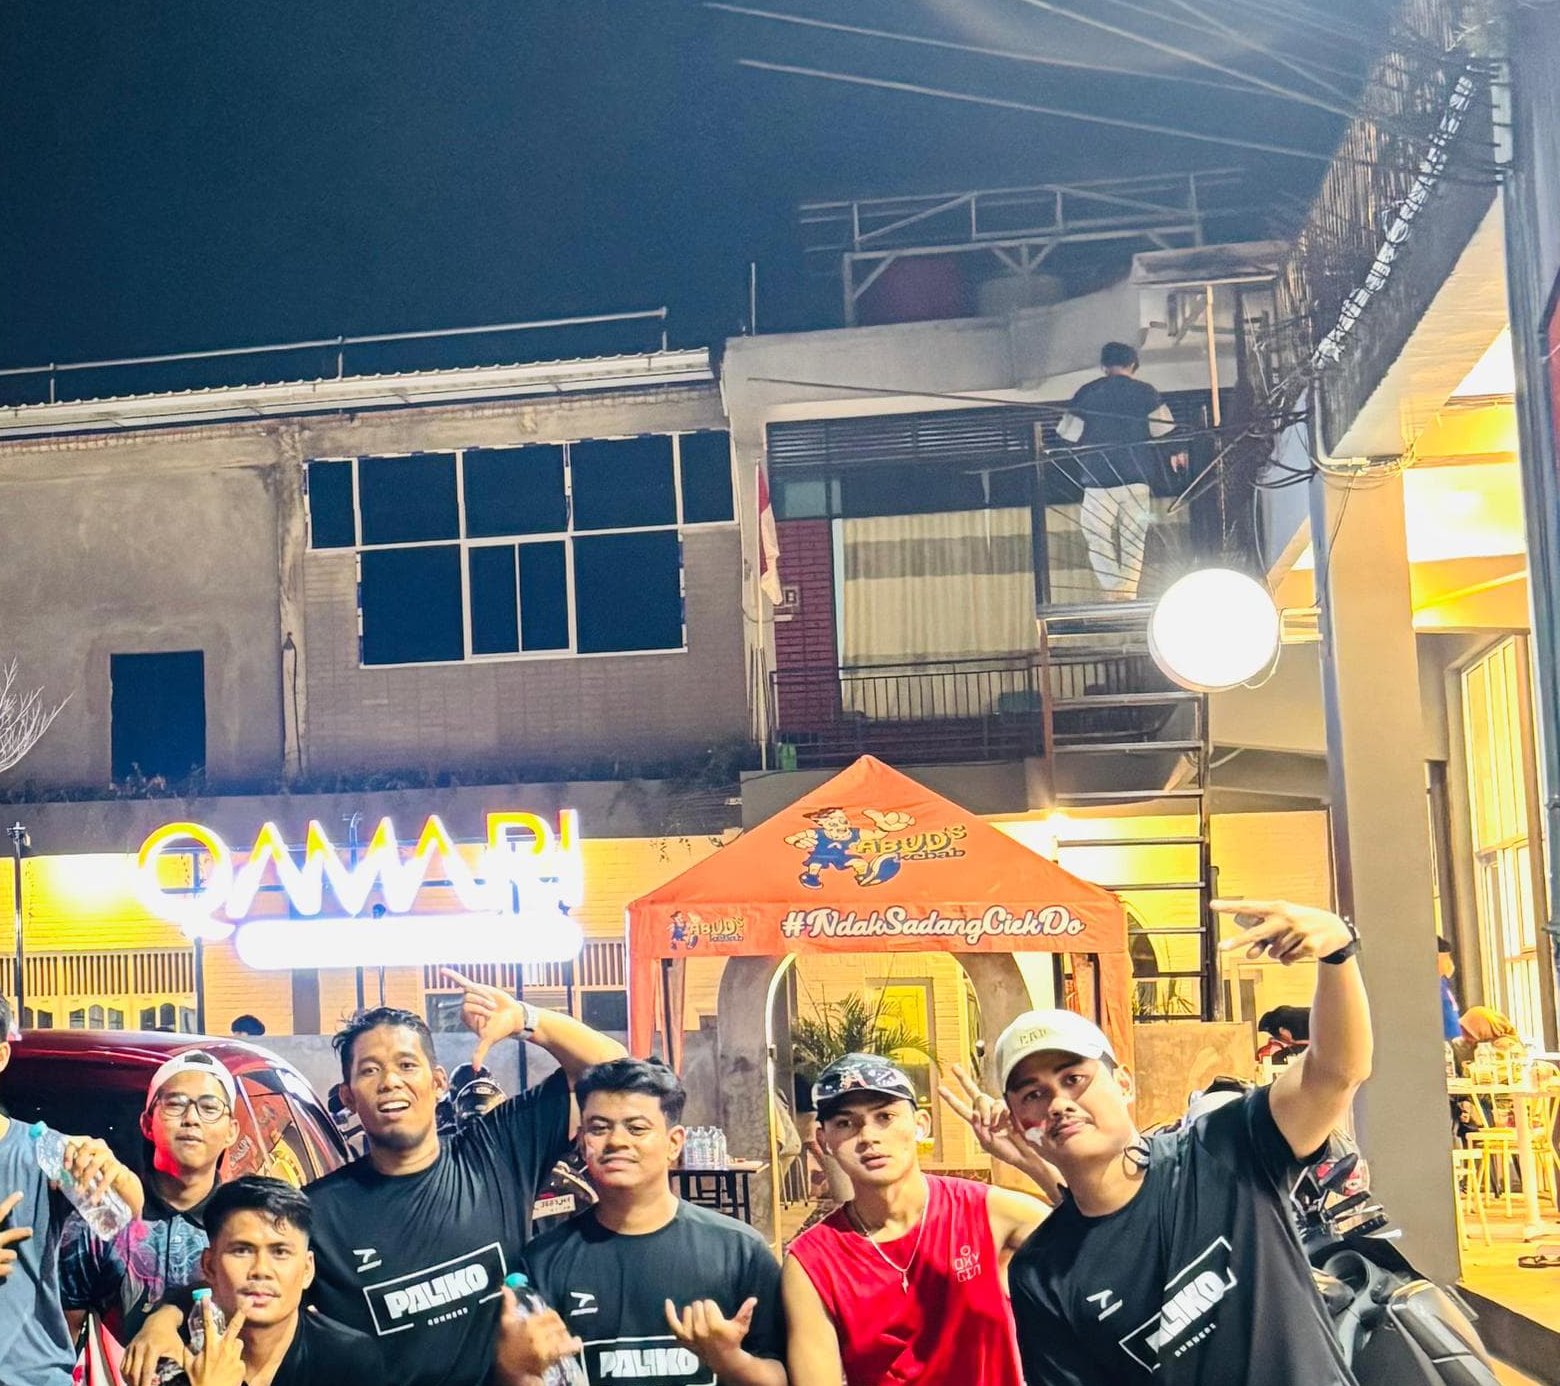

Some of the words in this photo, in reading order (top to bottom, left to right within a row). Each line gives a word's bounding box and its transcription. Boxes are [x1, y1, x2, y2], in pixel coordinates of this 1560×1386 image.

[894, 847, 966, 862] kebab
[383, 1263, 489, 1320] PALIKO
[599, 1347, 700, 1378] PALIKO
